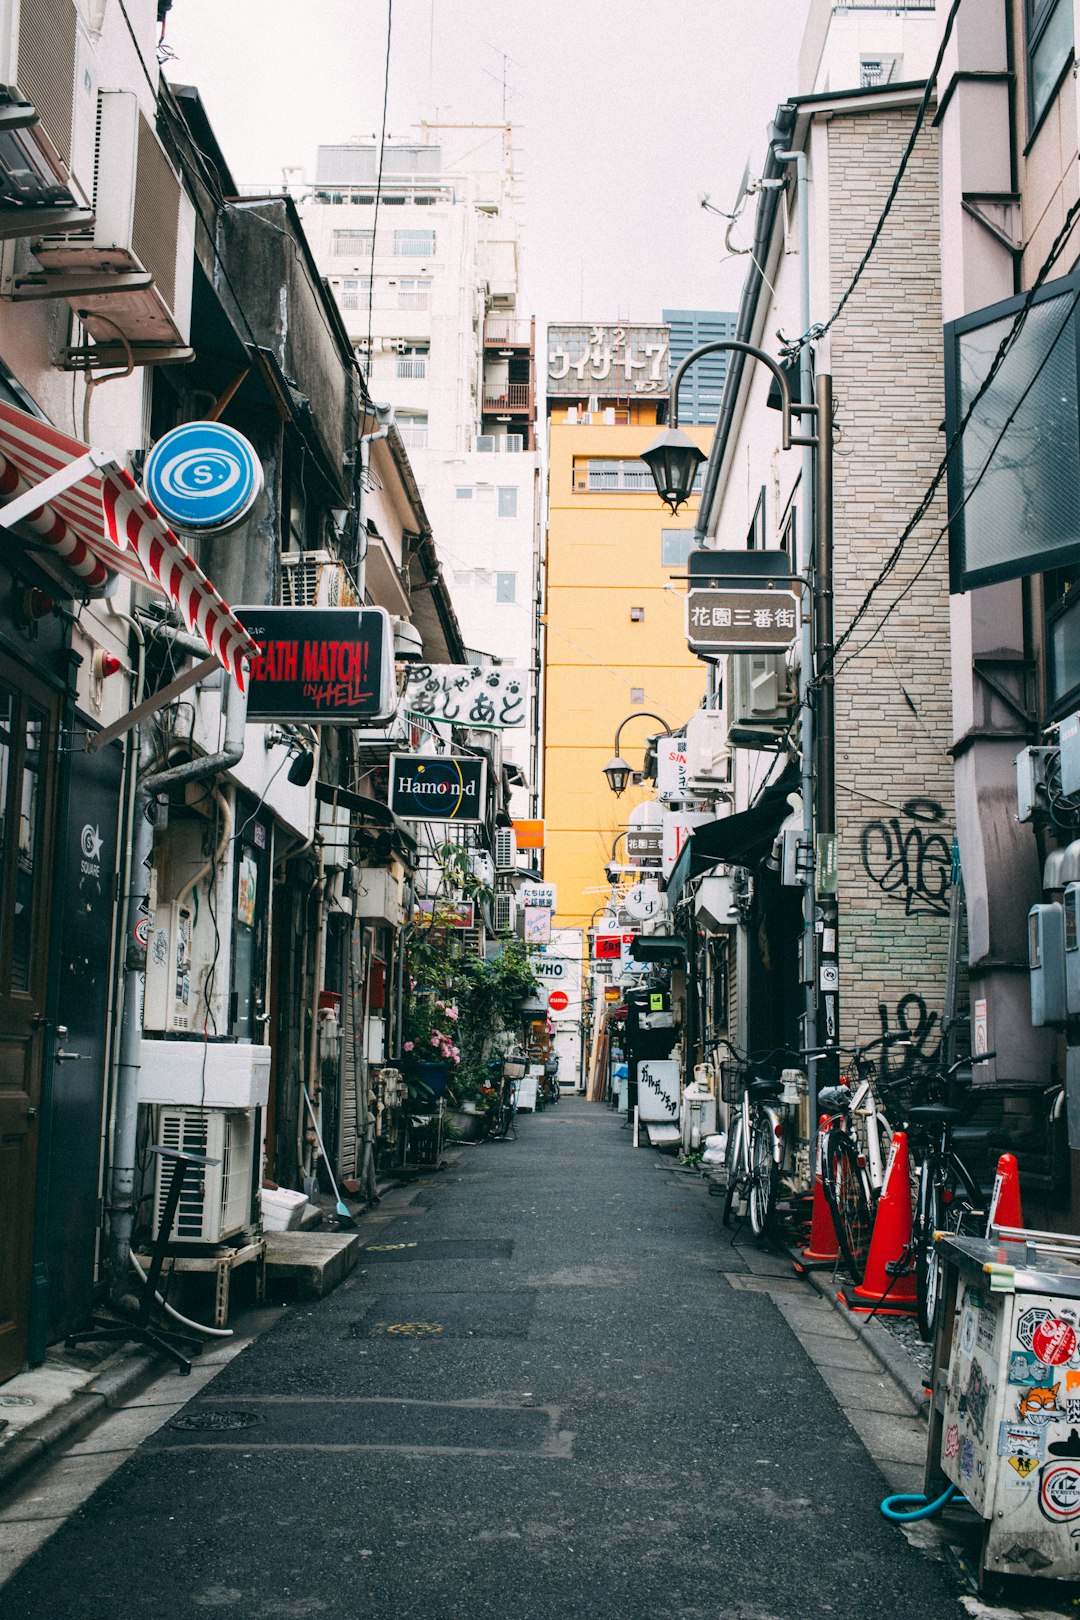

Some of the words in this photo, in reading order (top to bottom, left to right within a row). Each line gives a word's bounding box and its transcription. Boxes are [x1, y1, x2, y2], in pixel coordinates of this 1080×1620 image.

[691, 606, 795, 628] 花園三番街
[301, 640, 369, 682] MATCH!
[303, 683, 318, 697] IN
[311, 681, 373, 709] HELL
[411, 691, 526, 725] あしあと
[80, 859, 100, 878] SQUARE
[535, 964, 563, 975] WHO
[641, 1064, 677, 1116] ガルガンチュア
